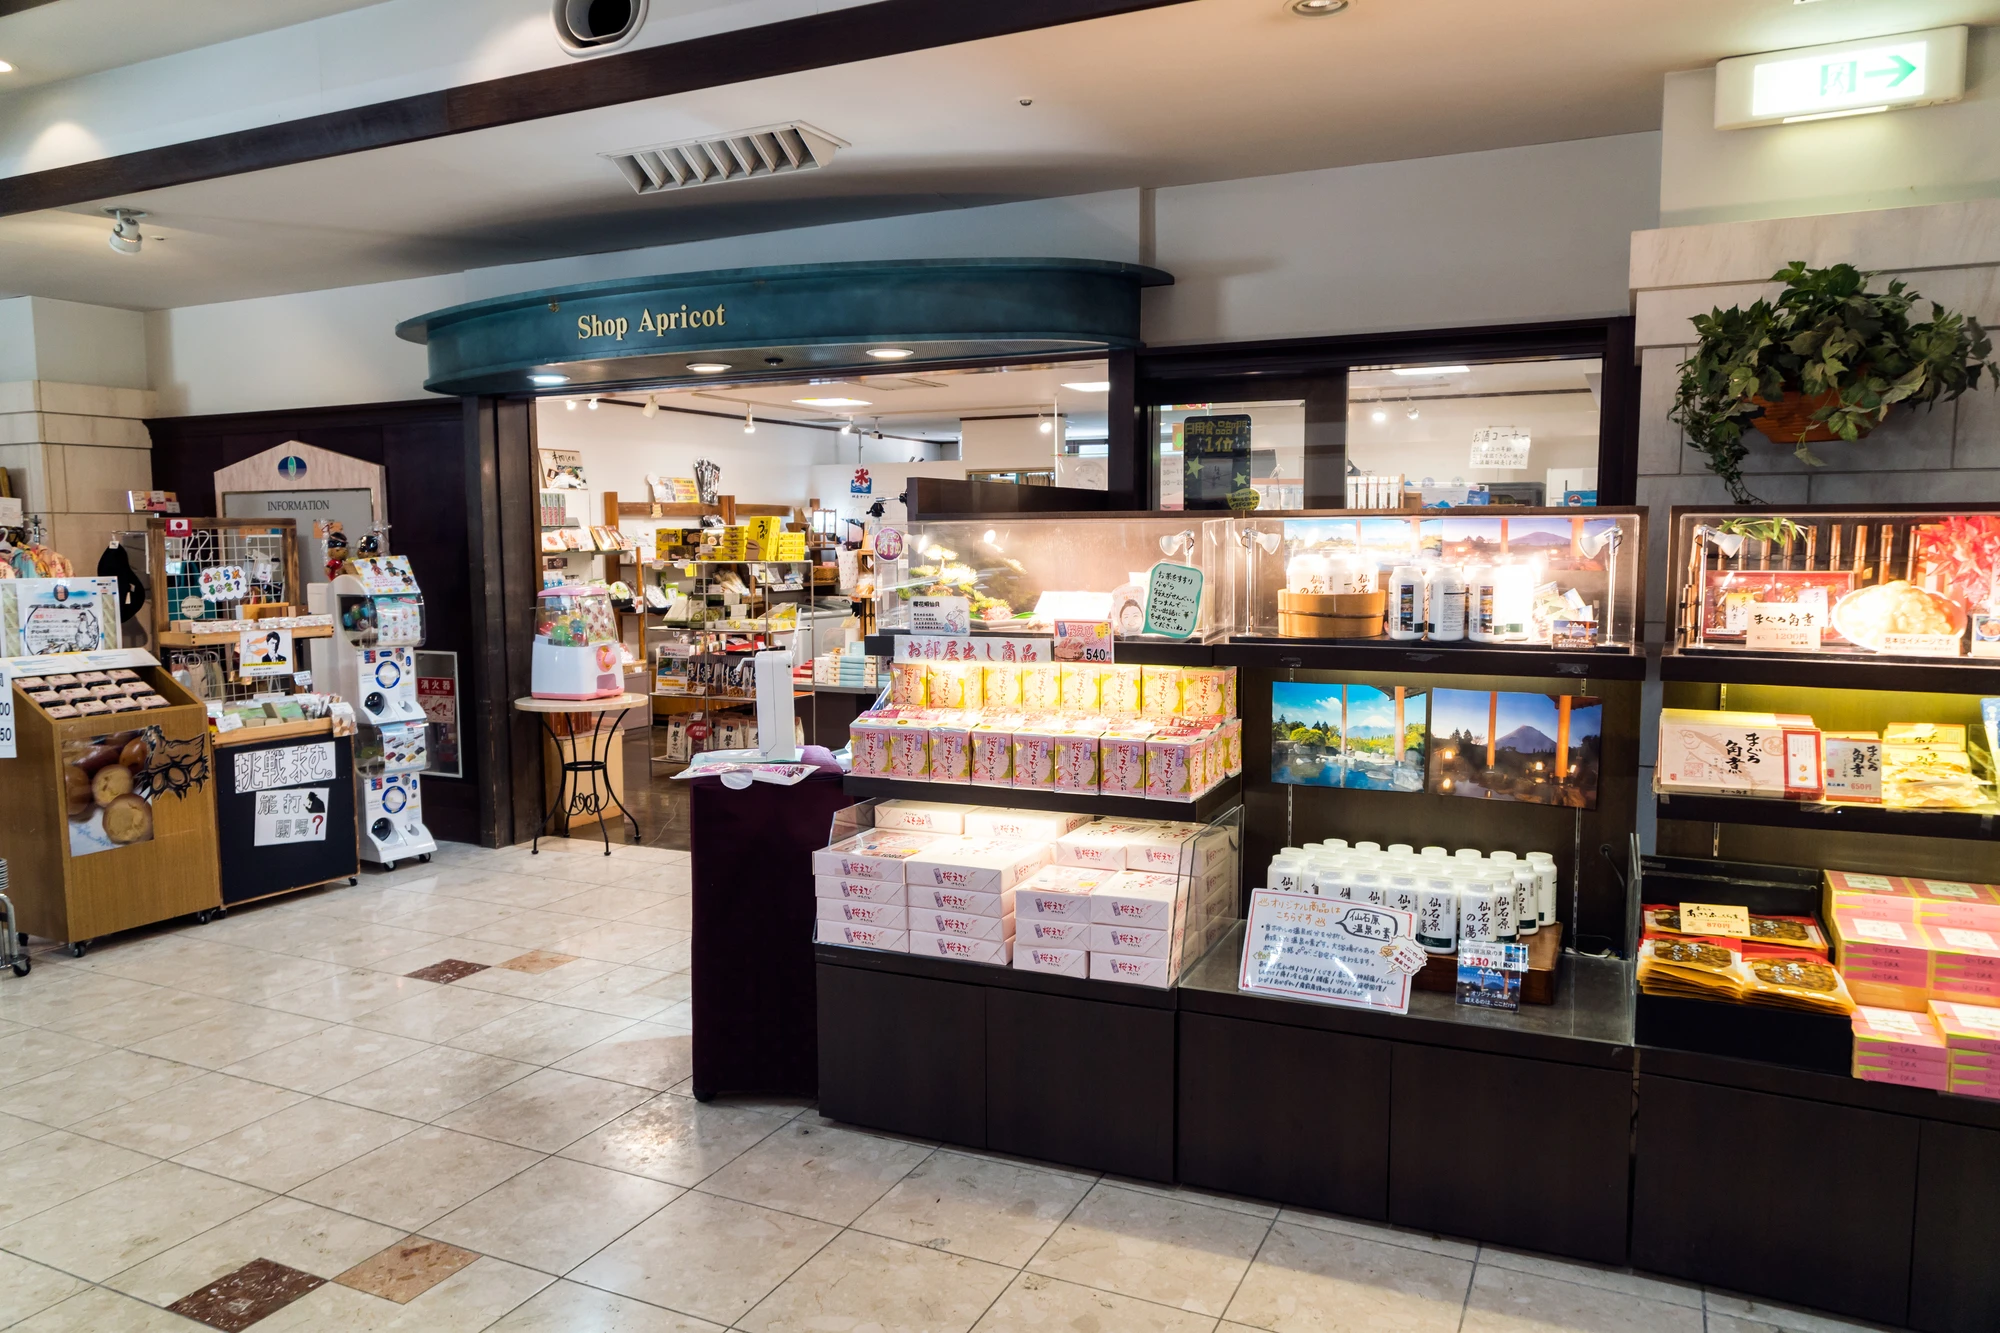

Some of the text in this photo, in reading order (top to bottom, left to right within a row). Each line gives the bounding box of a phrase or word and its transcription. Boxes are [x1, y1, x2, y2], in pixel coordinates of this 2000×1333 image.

[577, 303, 726, 340] Shop Apricot
[1473, 430, 1529, 442] お酒コーナー
[1204, 437, 1233, 452] 1位
[855, 468, 869, 485] 氷
[267, 500, 330, 511] INFORMATION
[1156, 581, 1175, 590] ながら
[1754, 613, 1815, 626] まぐろ角煮
[1067, 624, 1094, 637] 桜えび
[1885, 637, 1954, 645] 見本はイメージです。
[908, 640, 1038, 664] お部屋出し商品
[421, 680, 450, 690] 消火器
[1745, 732, 1762, 764] まぐろ
[1725, 740, 1745, 774] 角煮
[1850, 748, 1865, 777] 角煮
[1866, 745, 1879, 771] まぐろ
[235, 744, 333, 793] 挑戦求む。
[850, 862, 872, 873] 桜えび
[943, 871, 967, 883] 桜えび
[849, 884, 872, 895] 桜えび
[943, 895, 967, 907] 桜えび
[1043, 900, 1066, 911] 桜えび
[1271, 898, 1341, 914] オリジナル商品は
[851, 907, 875, 918] 桜えび
[1120, 903, 1143, 914] 桜えび
[1428, 897, 1441, 931] 仙石原
[1497, 896, 1510, 930] 仙石原
[1276, 911, 1312, 925] こちらです
[1349, 911, 1380, 926] 仙石原
[1478, 901, 1491, 935] 仙石原
[945, 919, 969, 930] 桜えび
[1465, 913, 1477, 938] の湯
[853, 930, 875, 941] 桜えび
[1042, 926, 1064, 936] 桜えび
[1352, 923, 1391, 940] 温泉の素
[1119, 933, 1142, 944] 桜えび
[946, 943, 971, 954] 桜えび
[1040, 953, 1061, 963] 桜えび
[1118, 962, 1141, 972] 桜えび
